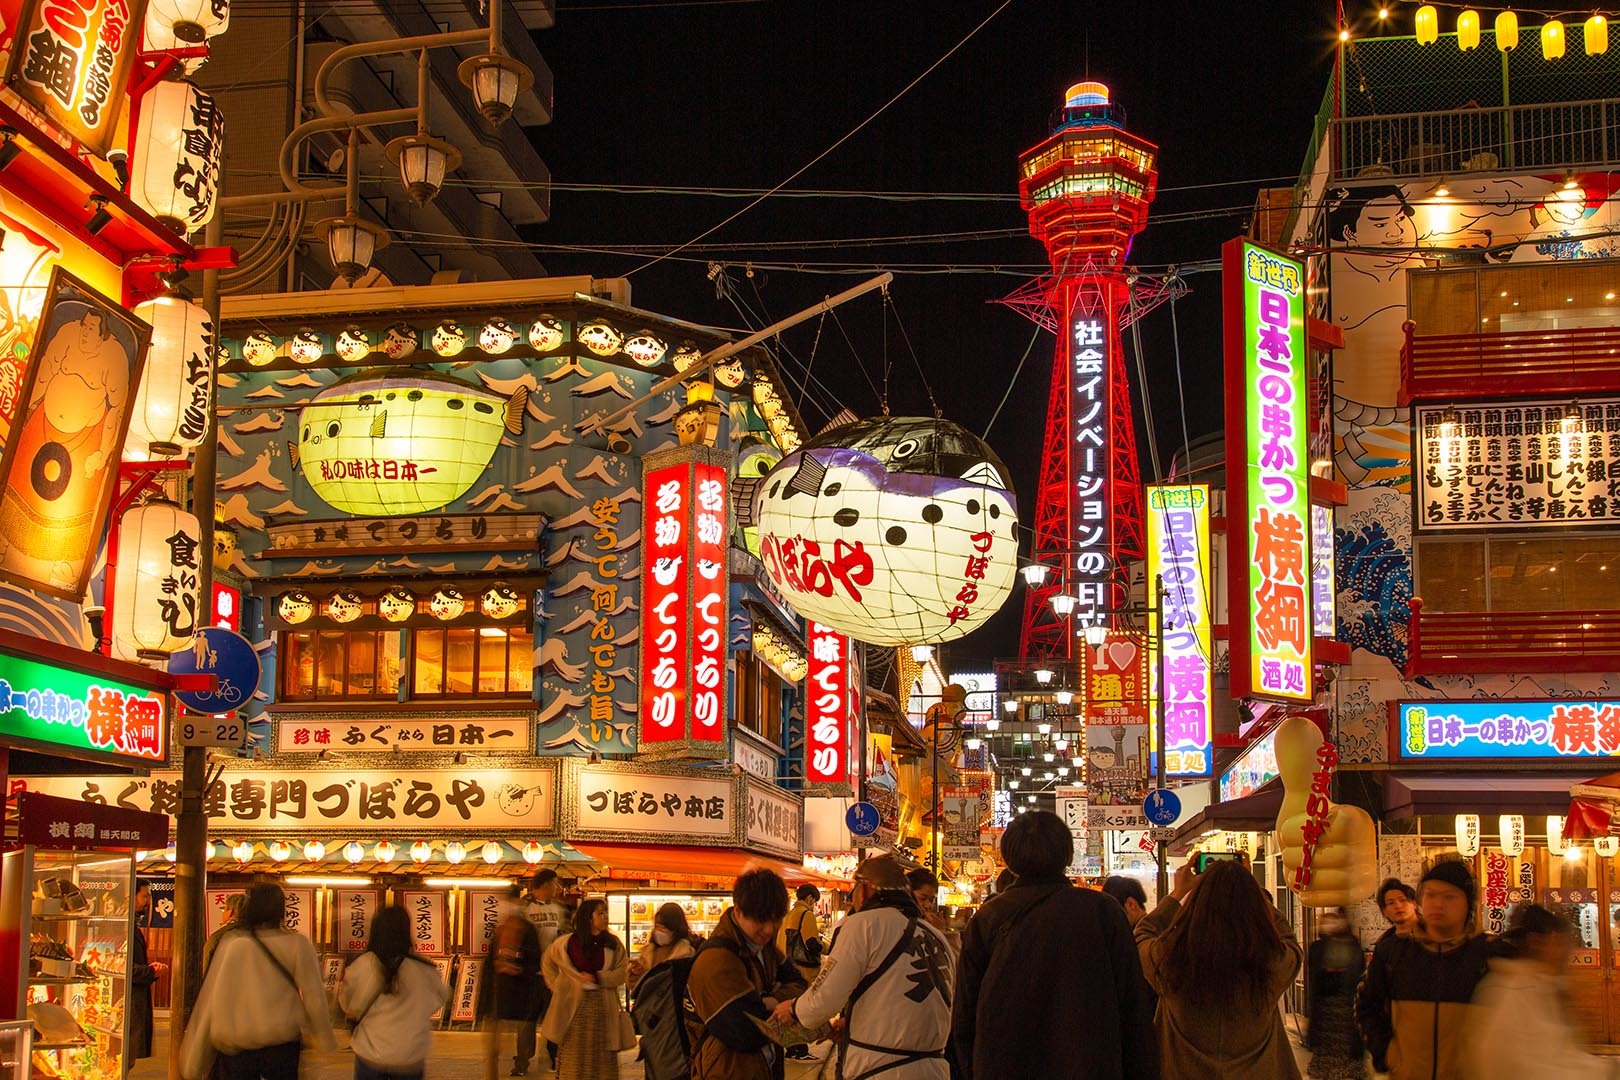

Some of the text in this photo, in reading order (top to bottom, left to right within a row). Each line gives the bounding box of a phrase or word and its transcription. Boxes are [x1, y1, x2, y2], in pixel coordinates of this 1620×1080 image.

[1247, 251, 1299, 295] 新世界
[1259, 289, 1296, 506] 日本一の串かつ
[1464, 411, 1482, 438] 前頭
[1484, 410, 1503, 437] 前頭
[1504, 409, 1523, 436] 前頭
[1524, 408, 1543, 436] 前頭
[1544, 408, 1563, 434] 前頭
[1585, 406, 1605, 432] 前頭
[320, 460, 438, 481] 私の味は日本一
[1426, 466, 1444, 522] もち
[1446, 465, 1466, 521] うずら玉子
[1466, 464, 1486, 521] 紅しょうが
[1485, 464, 1504, 520] にんにく
[1505, 463, 1524, 520] 玉ねぎ
[1526, 462, 1545, 519] 山芋
[1547, 462, 1566, 519] しし唐
[1566, 461, 1587, 518] れんこん
[761, 532, 875, 603] づぼらや
[946, 530, 996, 625] づぼらや
[1161, 511, 1197, 652] 日本一の串かつ
[1252, 508, 1306, 655] 横綱
[589, 496, 621, 743] 安うて何んでも旨い
[651, 479, 682, 728] 名物 てっちり
[694, 478, 724, 728] 名物 てっちり
[1155, 655, 1206, 748] 横綱
[1262, 660, 1304, 693] 酒処
[87, 687, 161, 756] 横綱
[293, 727, 331, 744] 珍味
[1408, 709, 1426, 753] 新世界
[1427, 717, 1548, 746] 日本一の串かつ
[587, 788, 725, 821] づぼらや本店
[1106, 816, 1149, 827] くら寿司
[1486, 852, 1509, 934] お座敷あり
[1572, 956, 1593, 964] 入口
